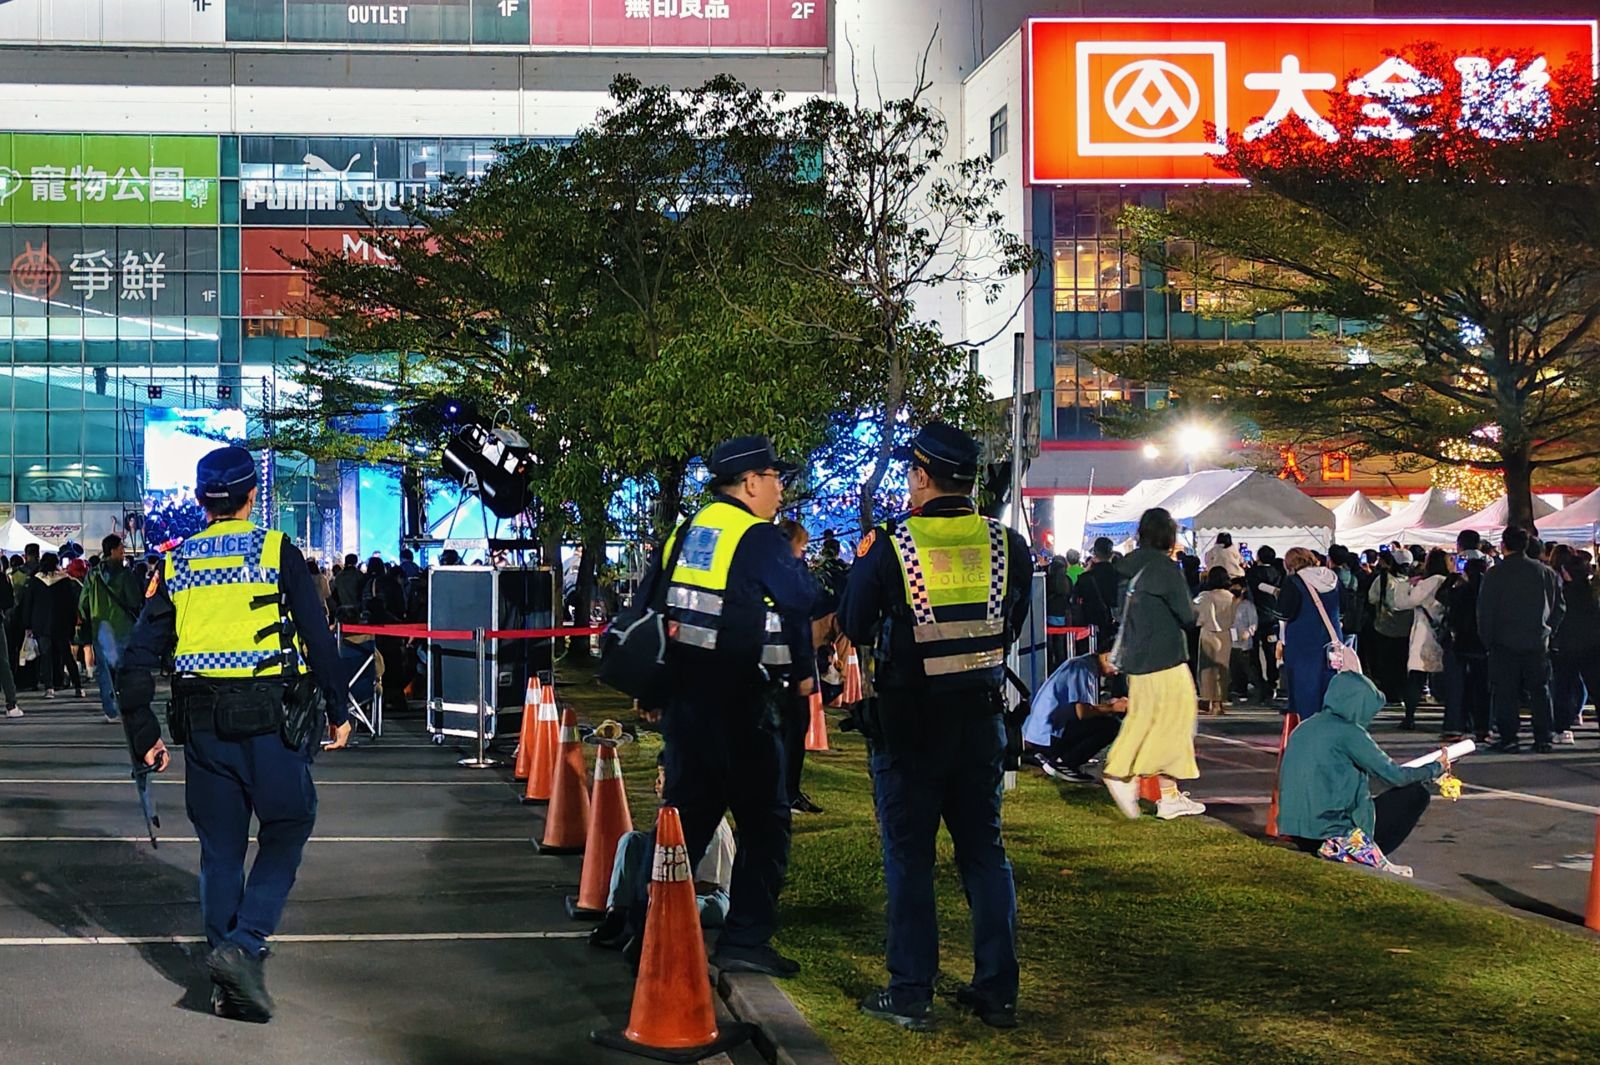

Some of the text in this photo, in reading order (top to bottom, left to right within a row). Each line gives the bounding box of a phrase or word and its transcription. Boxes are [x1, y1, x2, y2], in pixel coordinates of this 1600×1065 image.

[347, 5, 409, 24] OUTLET
[498, 2, 518, 17] 1F
[624, 0, 731, 19] 無印良品
[791, 2, 815, 19] 2F
[30, 164, 185, 202] 寵物公園
[191, 196, 207, 209] 3F
[69, 249, 166, 301] 爭鮮
[201, 290, 217, 302] 1F
[1278, 444, 1352, 482] 入口
[188, 536, 250, 557] POLICE
